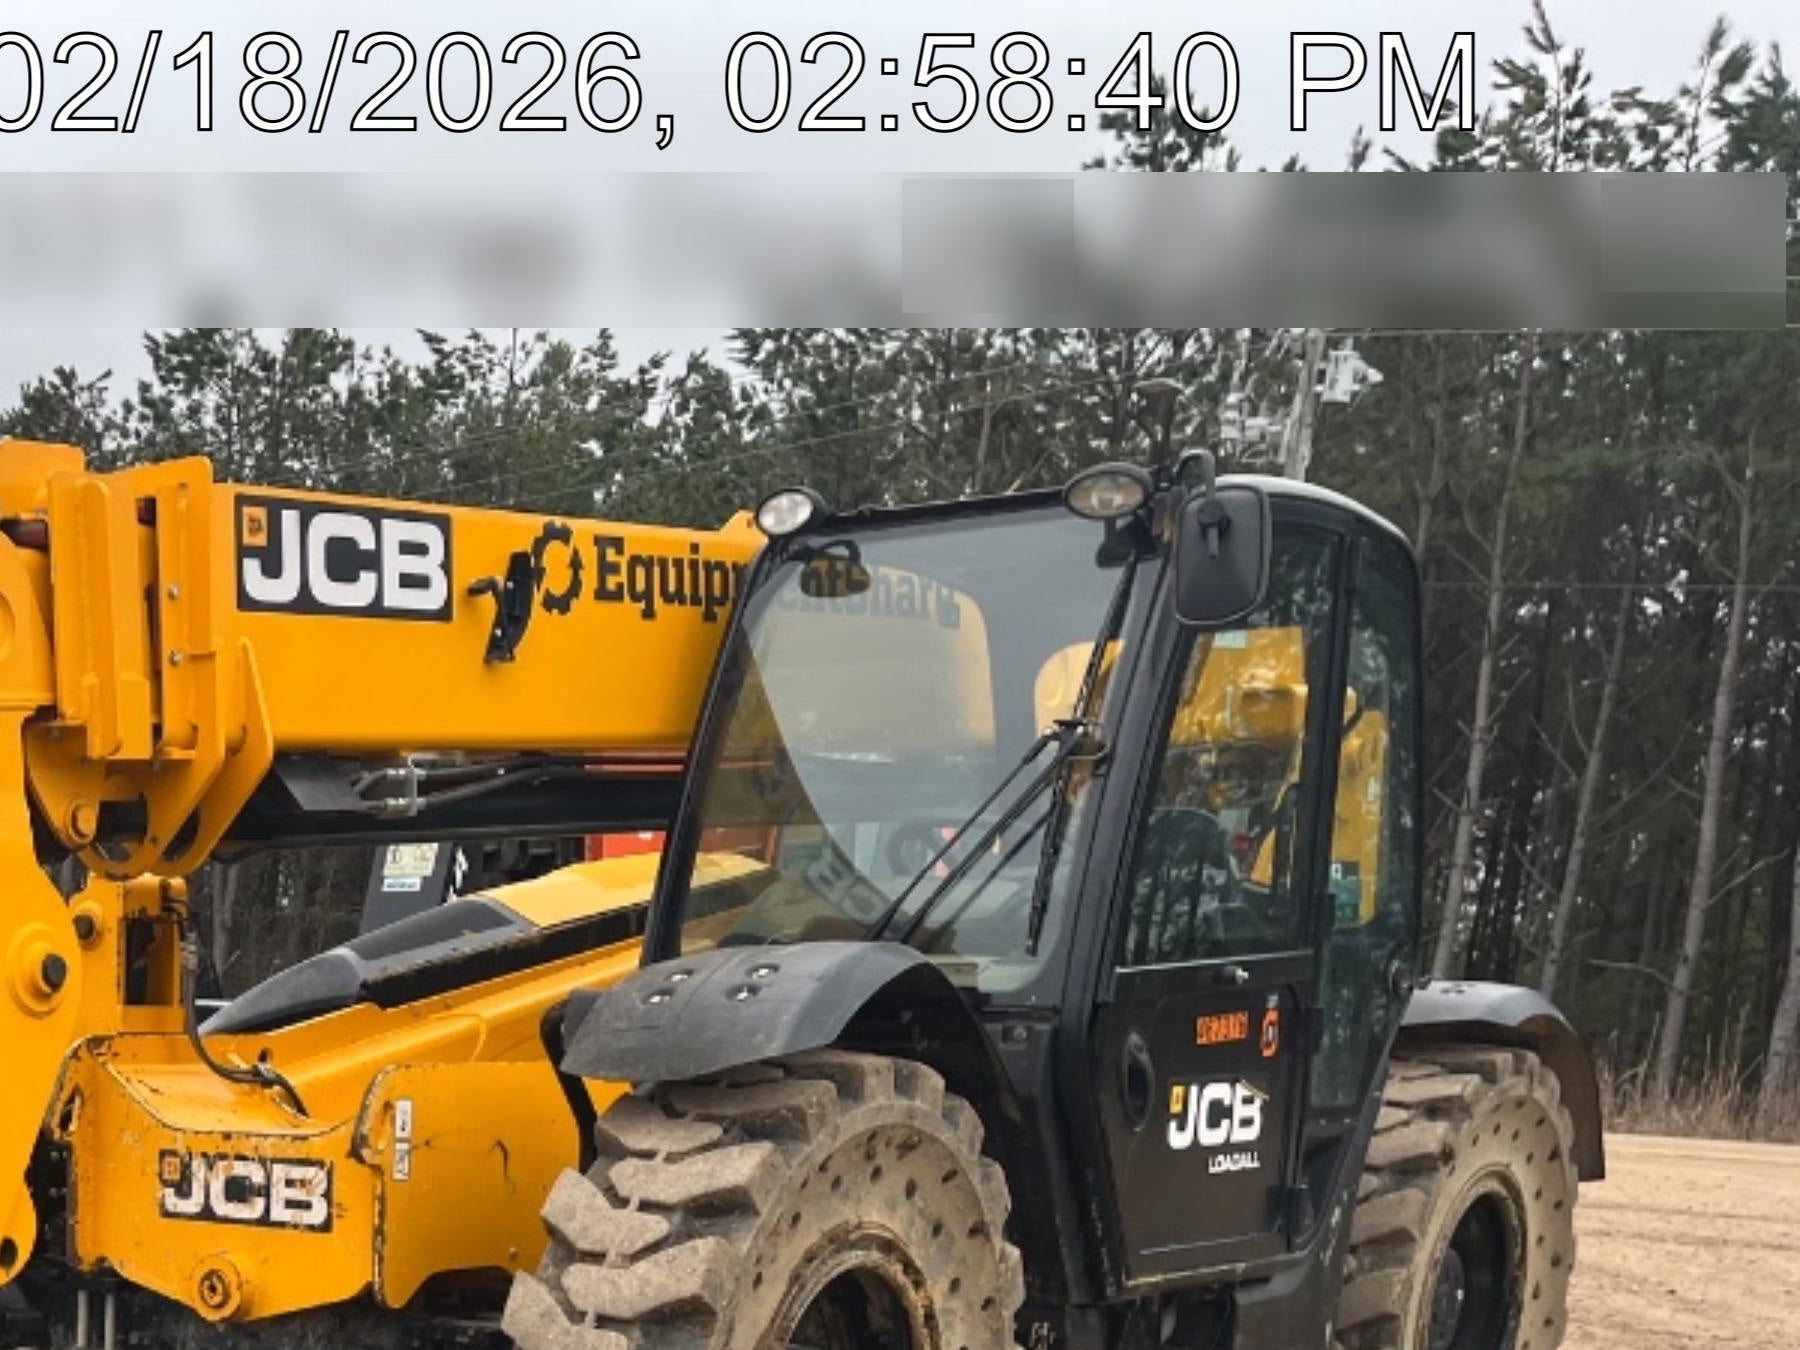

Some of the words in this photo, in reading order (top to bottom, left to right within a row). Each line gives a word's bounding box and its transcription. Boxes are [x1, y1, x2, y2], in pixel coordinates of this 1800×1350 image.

[242, 508, 449, 611] JCB
[1168, 1081, 1262, 1151] JCB
[162, 1155, 329, 1227] JCB
[1207, 1150, 1261, 1175] LOADALL
